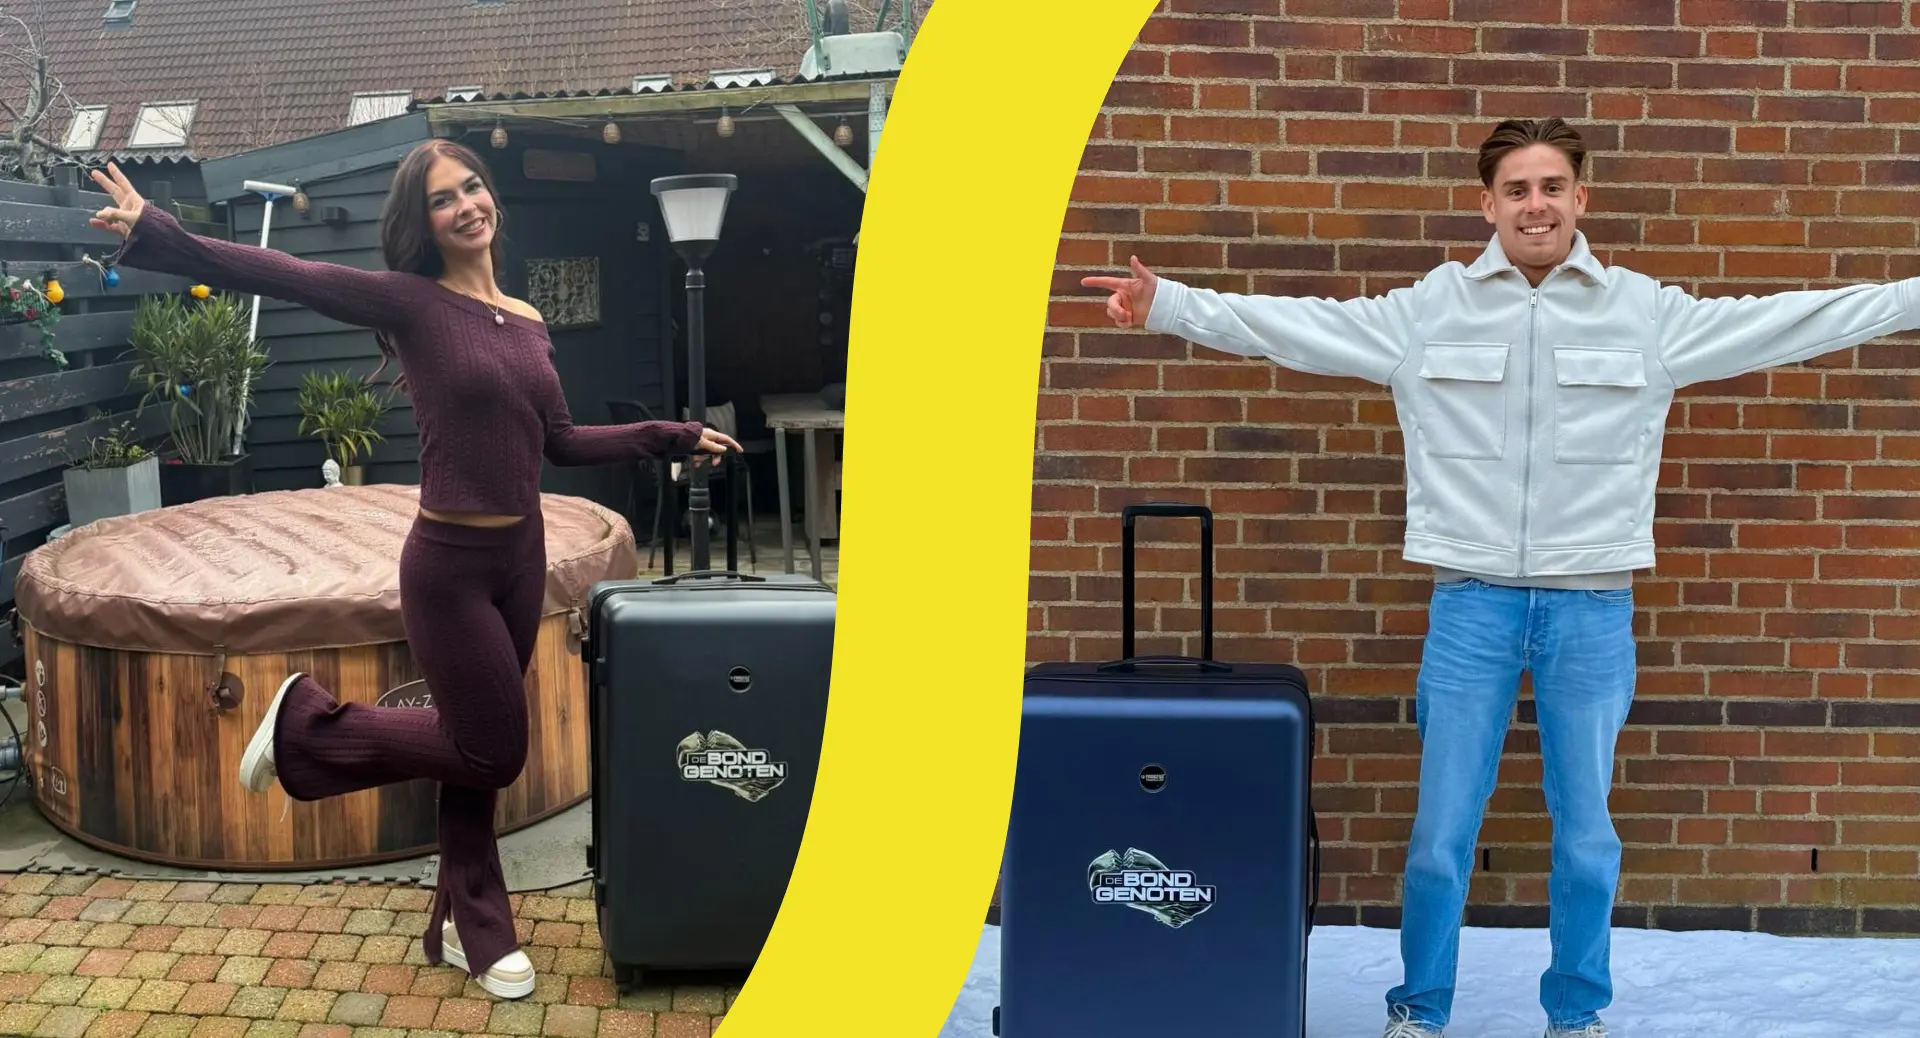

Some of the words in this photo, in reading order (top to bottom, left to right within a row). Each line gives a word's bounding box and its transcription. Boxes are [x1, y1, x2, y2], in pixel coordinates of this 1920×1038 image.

[691, 756, 706, 764] DE
[707, 751, 767, 765] BOND
[683, 764, 785, 779] GENOTEN
[1105, 877, 1123, 885] DE
[1123, 872, 1192, 887] BOND
[1095, 886, 1212, 902] GENOTEN
